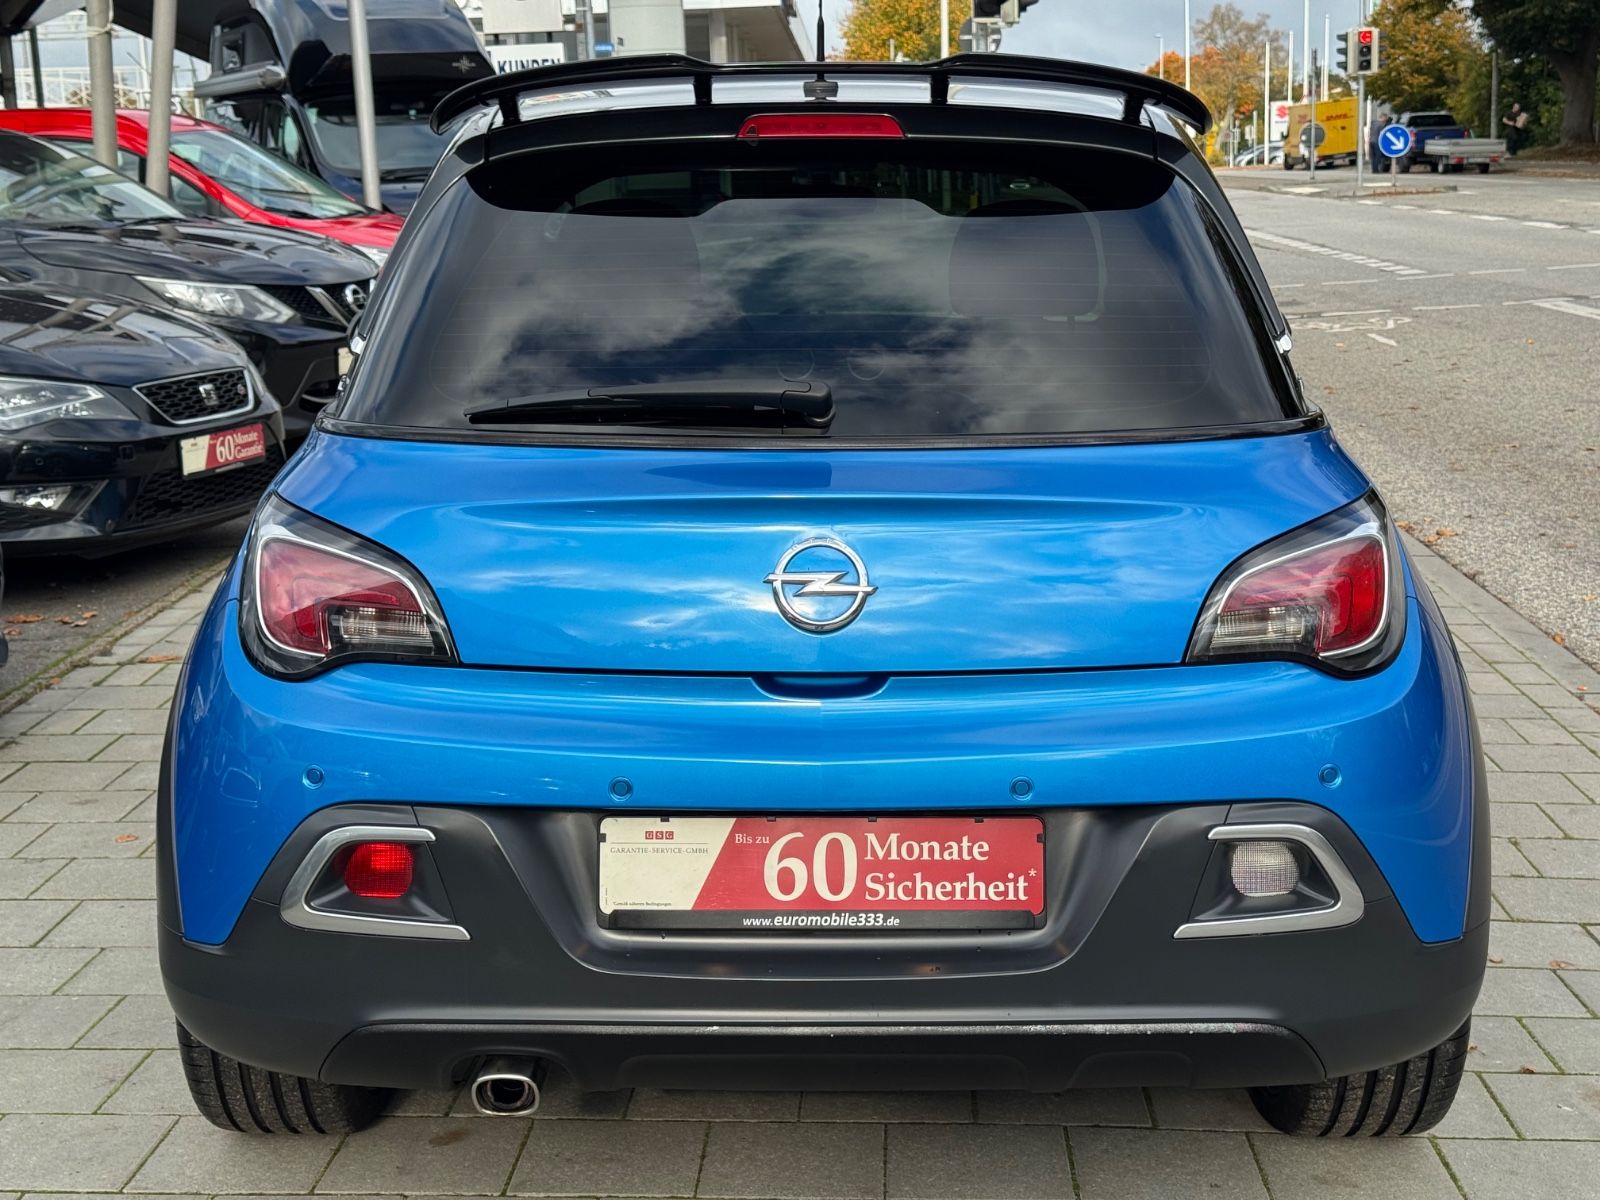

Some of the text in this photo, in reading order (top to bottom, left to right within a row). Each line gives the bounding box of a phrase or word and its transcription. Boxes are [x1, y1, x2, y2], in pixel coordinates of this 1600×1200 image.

[216, 435, 234, 463] 60
[645, 831, 674, 840] GSG
[735, 832, 990, 901] Bis zu 60 Monate
[743, 913, 900, 926] www.euromobile333.de
